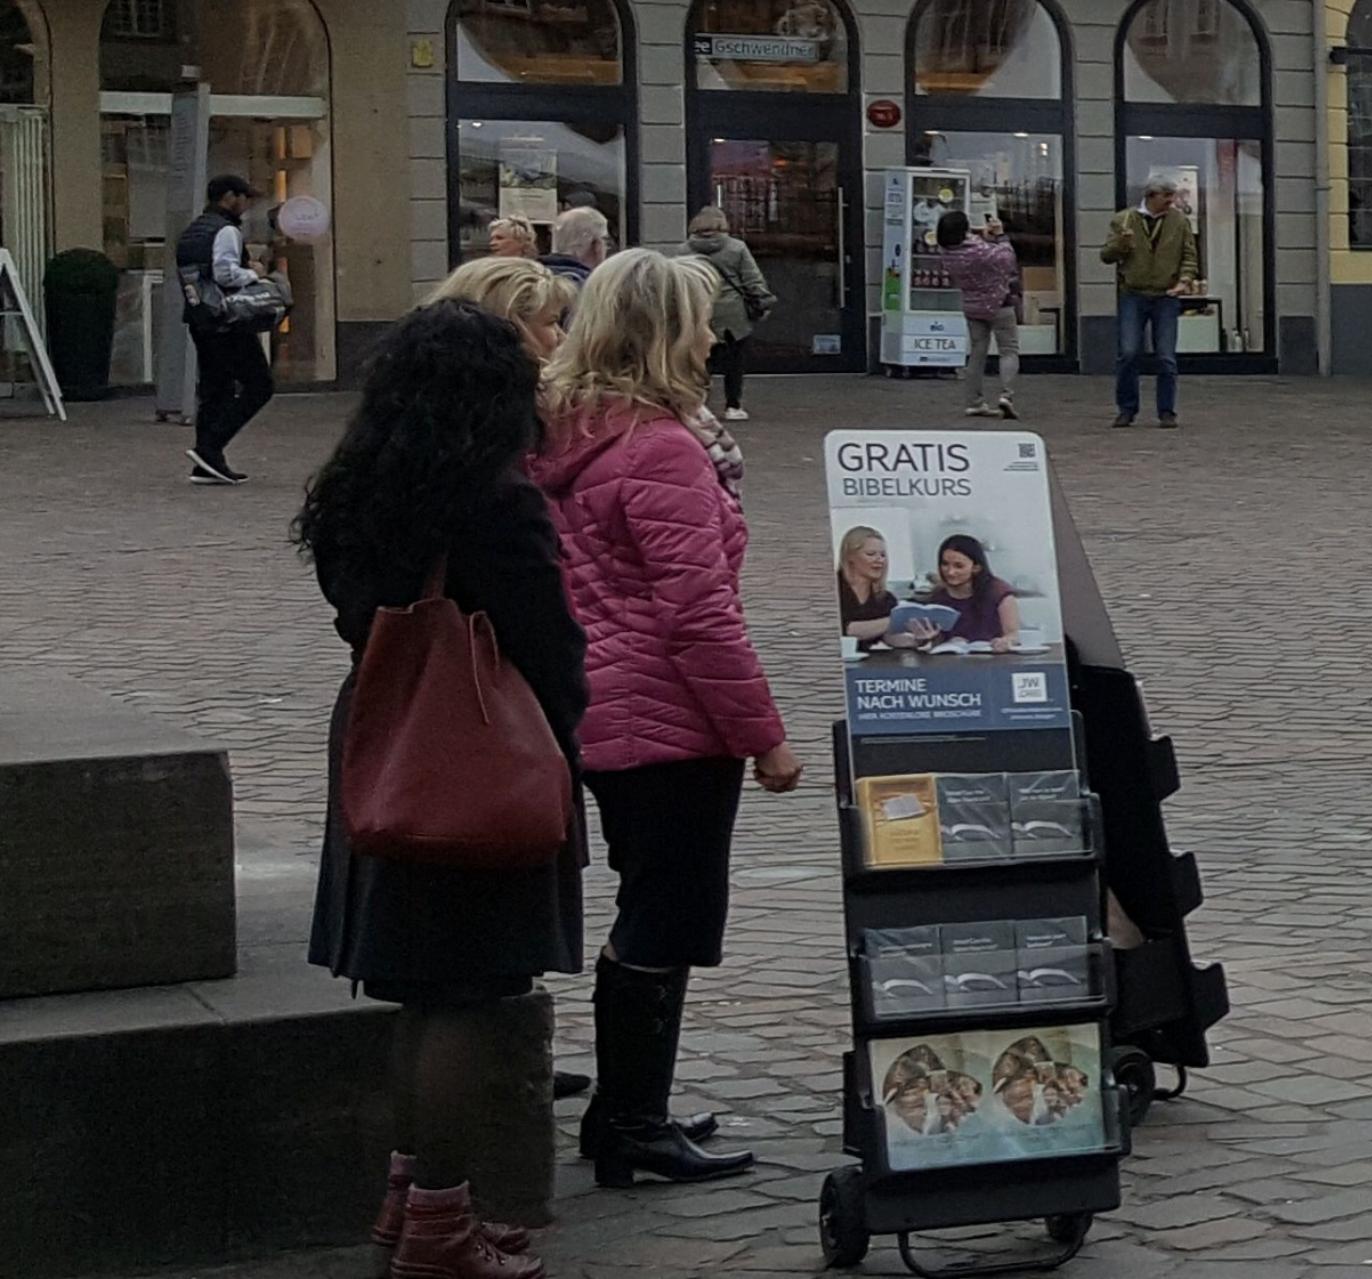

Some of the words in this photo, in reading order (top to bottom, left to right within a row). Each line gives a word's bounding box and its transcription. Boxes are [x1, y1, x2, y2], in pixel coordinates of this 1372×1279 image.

[838, 443, 970, 472] GRATIS
[843, 477, 972, 497] BIBELKURS
[855, 679, 927, 693] TERMINE
[857, 696, 902, 709] NACH
[908, 693, 982, 707] WUNSCH
